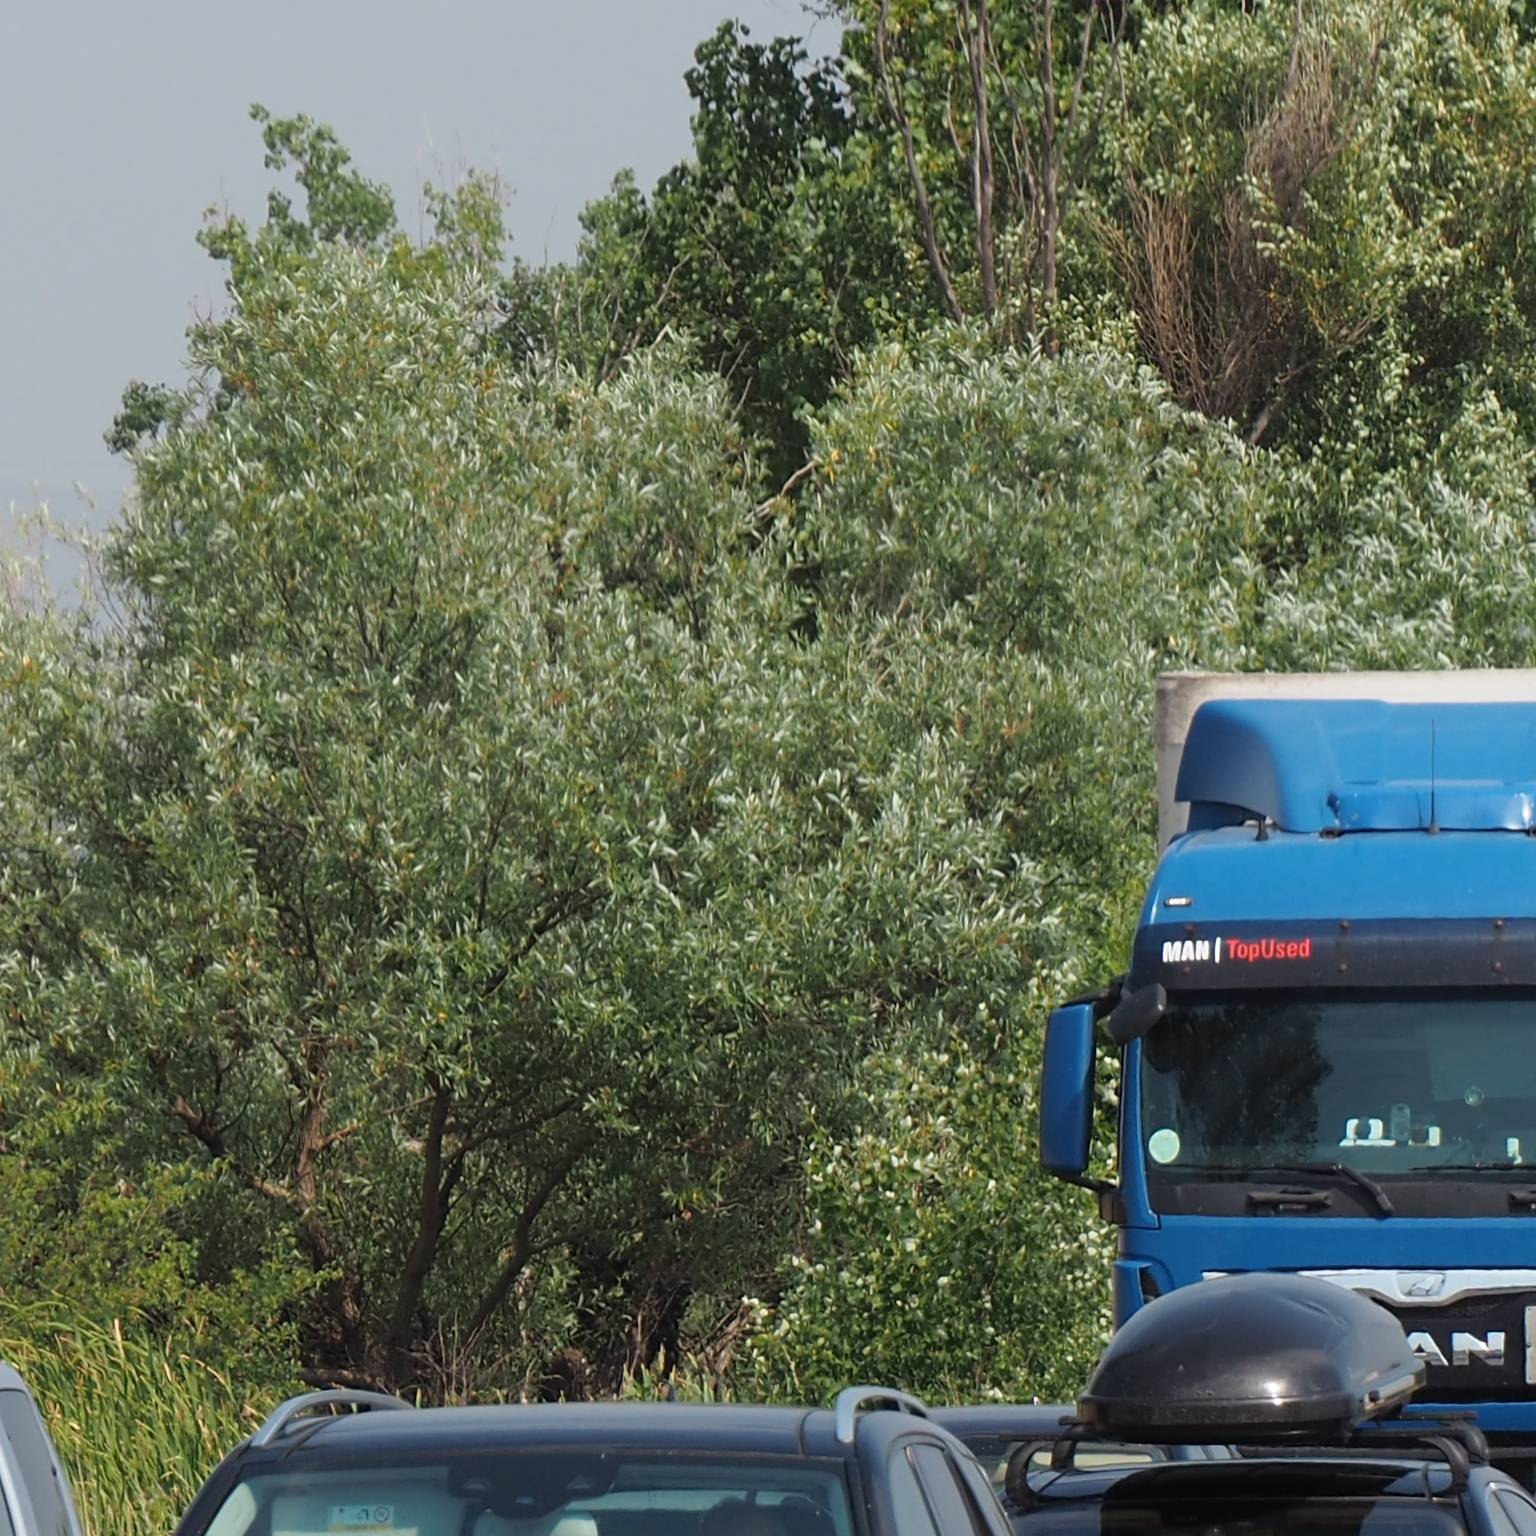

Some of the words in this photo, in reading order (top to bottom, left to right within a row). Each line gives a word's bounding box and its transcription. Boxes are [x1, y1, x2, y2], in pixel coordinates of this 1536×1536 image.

[1162, 940, 1210, 963] MAN
[1226, 938, 1312, 962] TopUsed
[1407, 1332, 1505, 1366] AN
